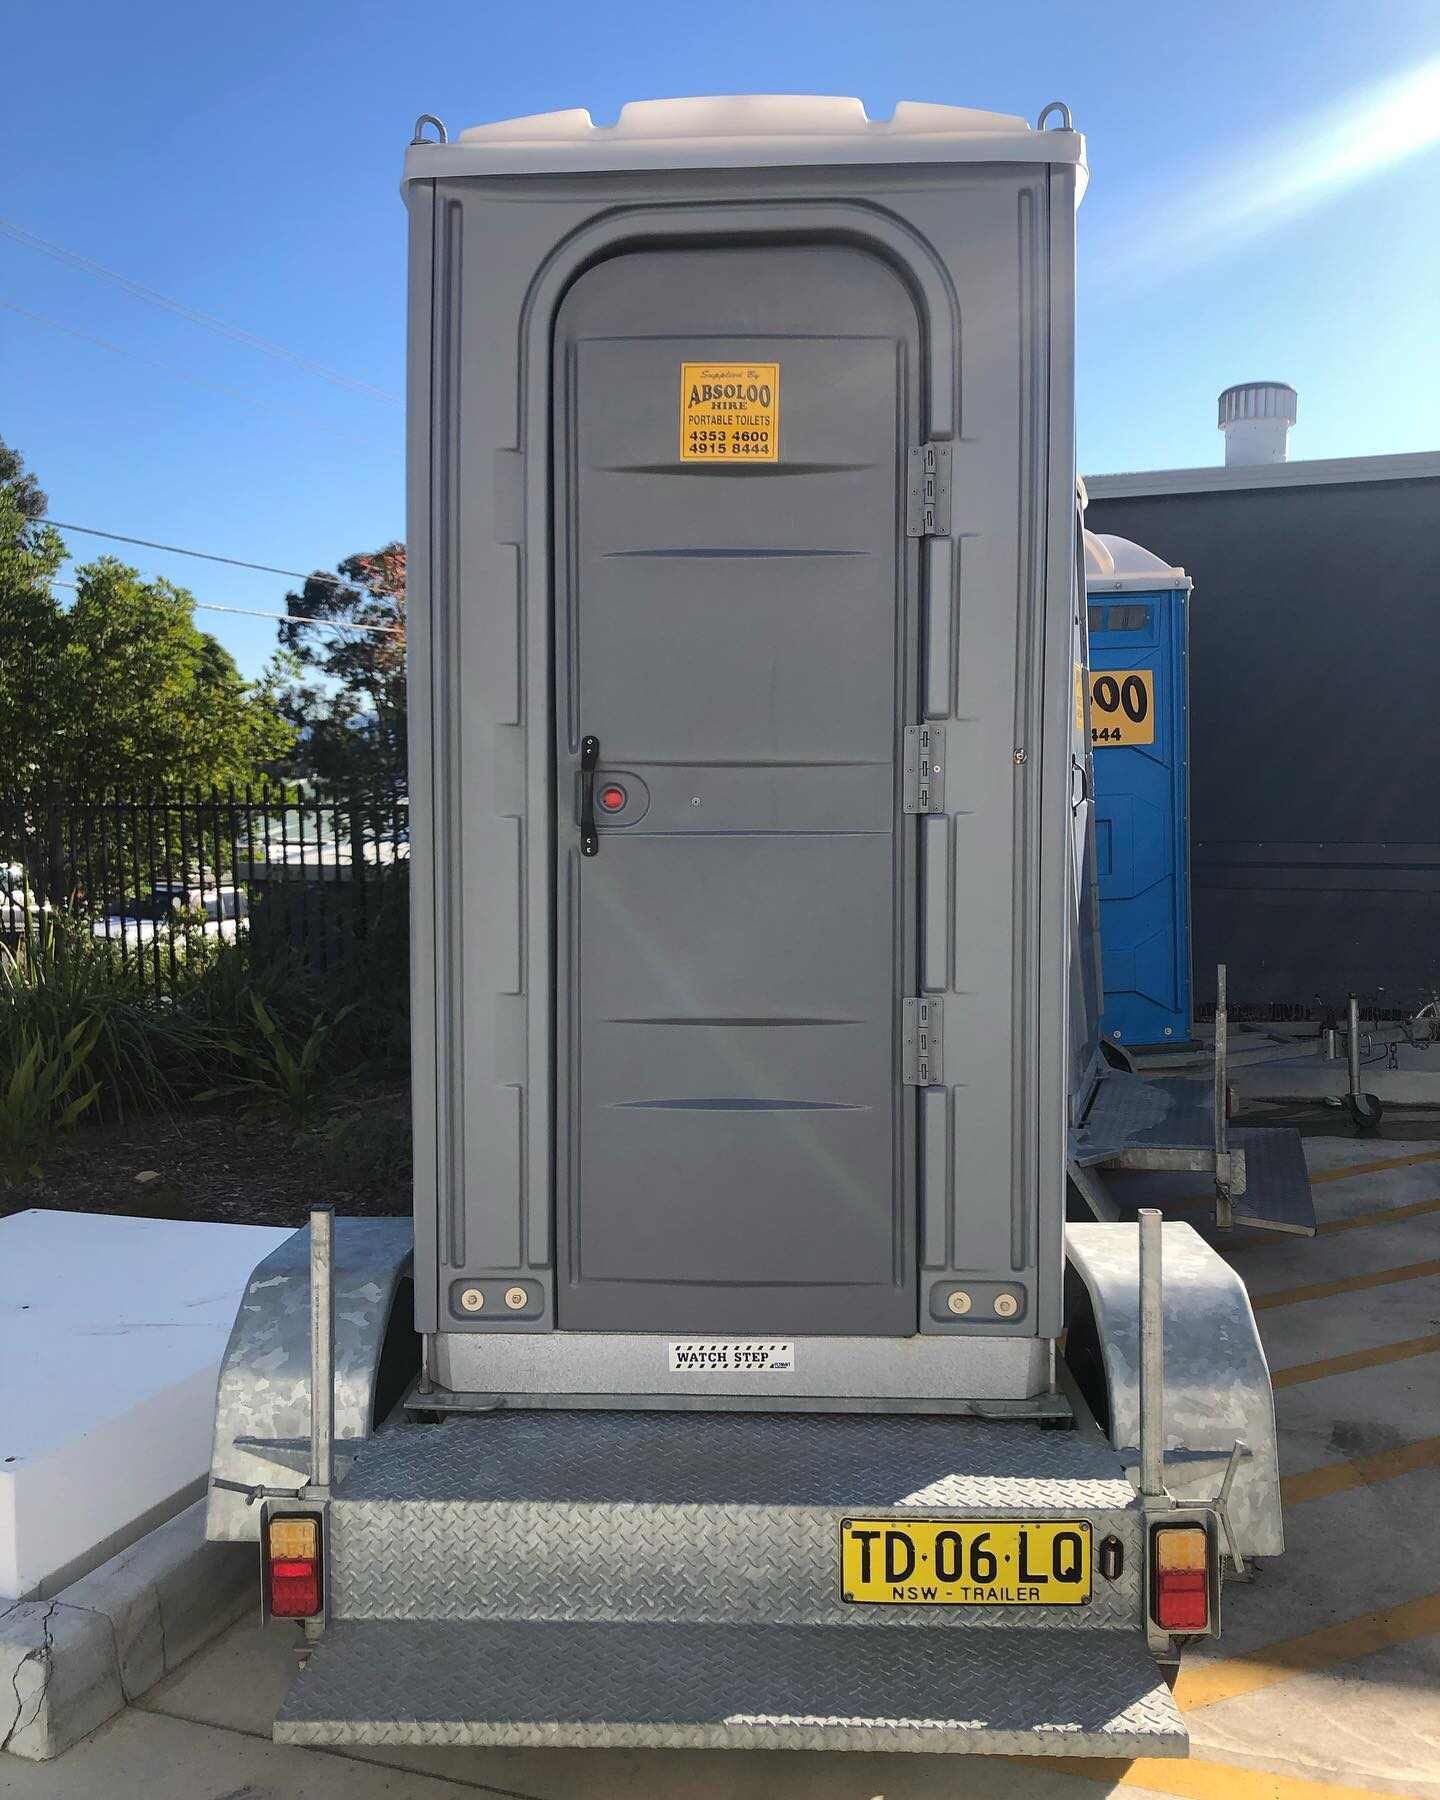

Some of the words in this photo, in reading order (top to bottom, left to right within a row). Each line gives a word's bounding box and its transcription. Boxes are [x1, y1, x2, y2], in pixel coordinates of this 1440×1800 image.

[688, 384, 771, 408] ABSOLOO
[711, 401, 748, 410] HIRE
[688, 414, 733, 425] PORTABLE
[735, 415, 770, 426] TOILETS
[689, 431, 726, 441] 4353
[731, 431, 769, 442] 4600
[689, 443, 726, 454] 4915
[732, 444, 769, 454] 8444
[1091, 675, 1148, 723] OO
[677, 1352, 727, 1363] WATCH
[734, 1352, 769, 1362] STEP
[892, 1586, 937, 1600] NSW
[960, 1587, 1040, 1601] TRAILER
